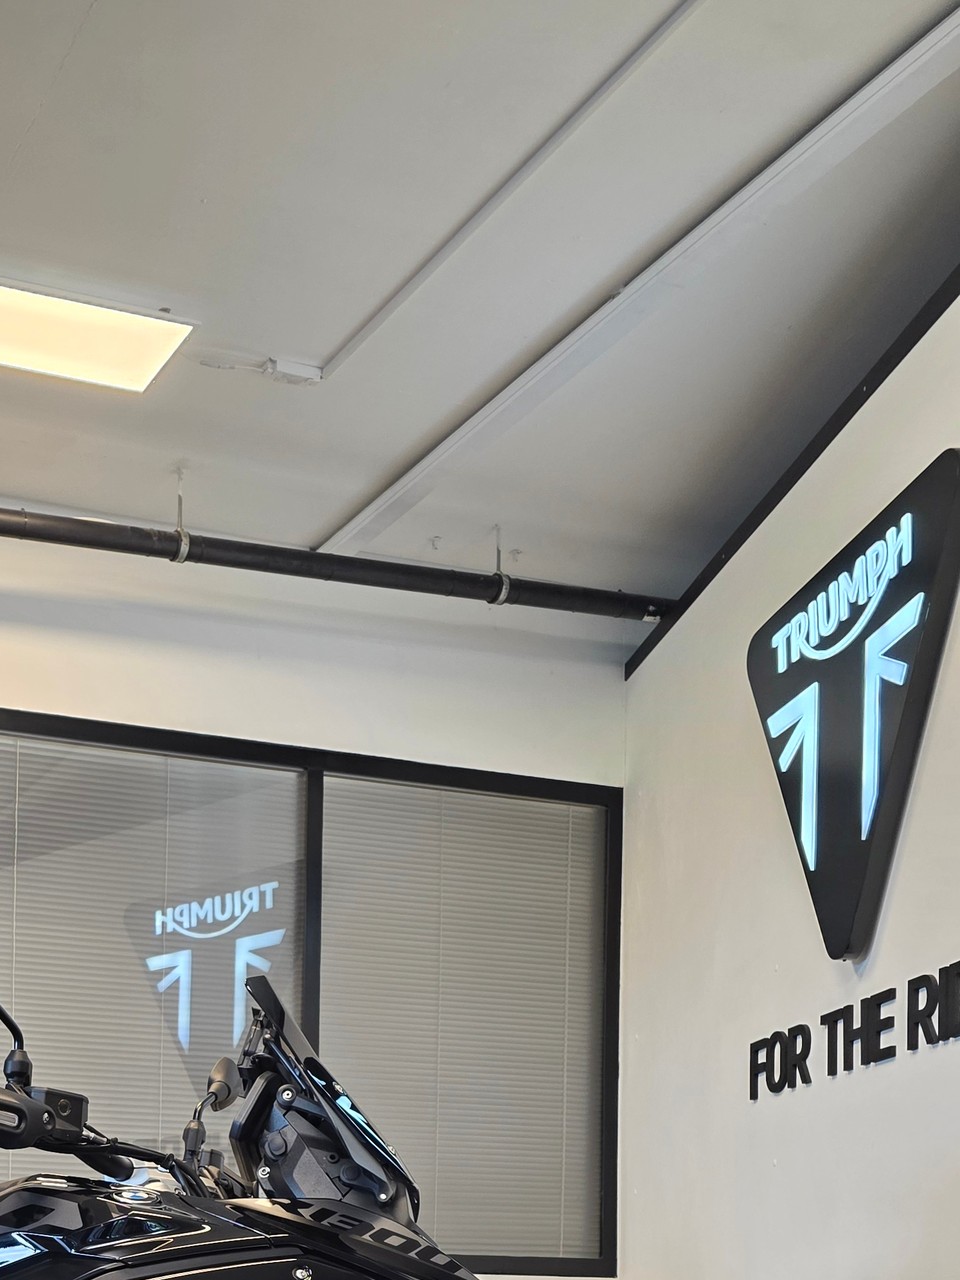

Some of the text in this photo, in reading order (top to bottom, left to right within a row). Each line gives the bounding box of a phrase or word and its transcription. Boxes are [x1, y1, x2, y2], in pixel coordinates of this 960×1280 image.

[771, 512, 913, 675] TRIUMPH
[750, 1024, 812, 1101] FOR
[820, 988, 897, 1077] THE
